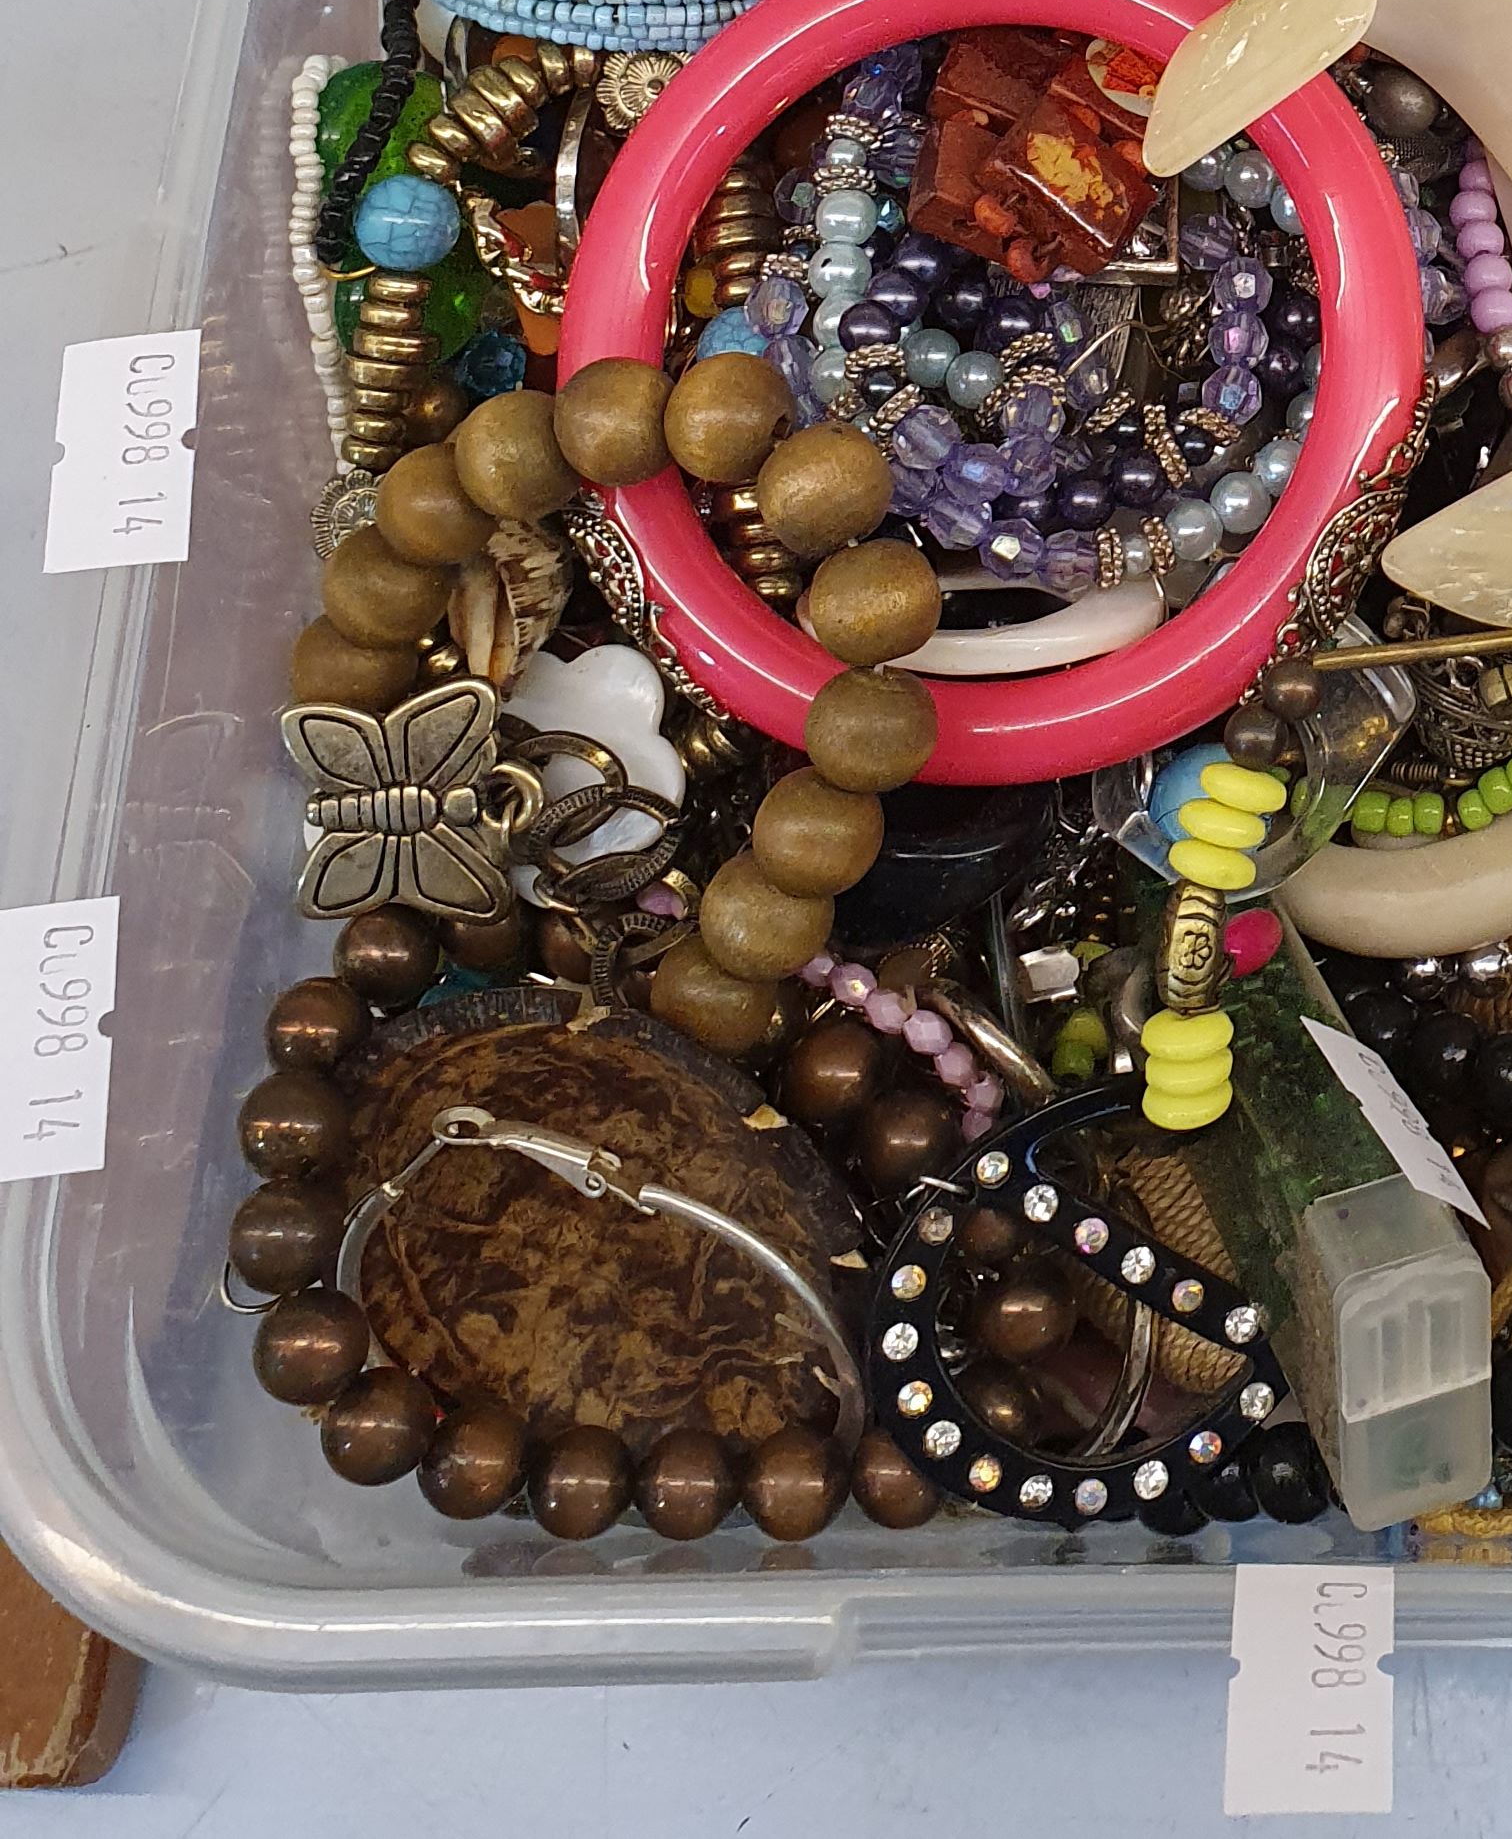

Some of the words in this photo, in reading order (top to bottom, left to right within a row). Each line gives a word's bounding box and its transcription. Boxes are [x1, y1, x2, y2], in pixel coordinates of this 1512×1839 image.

[111, 489, 168, 537] 14
[21, 1089, 83, 1140] 14
[1304, 1722, 1366, 1775] 14
